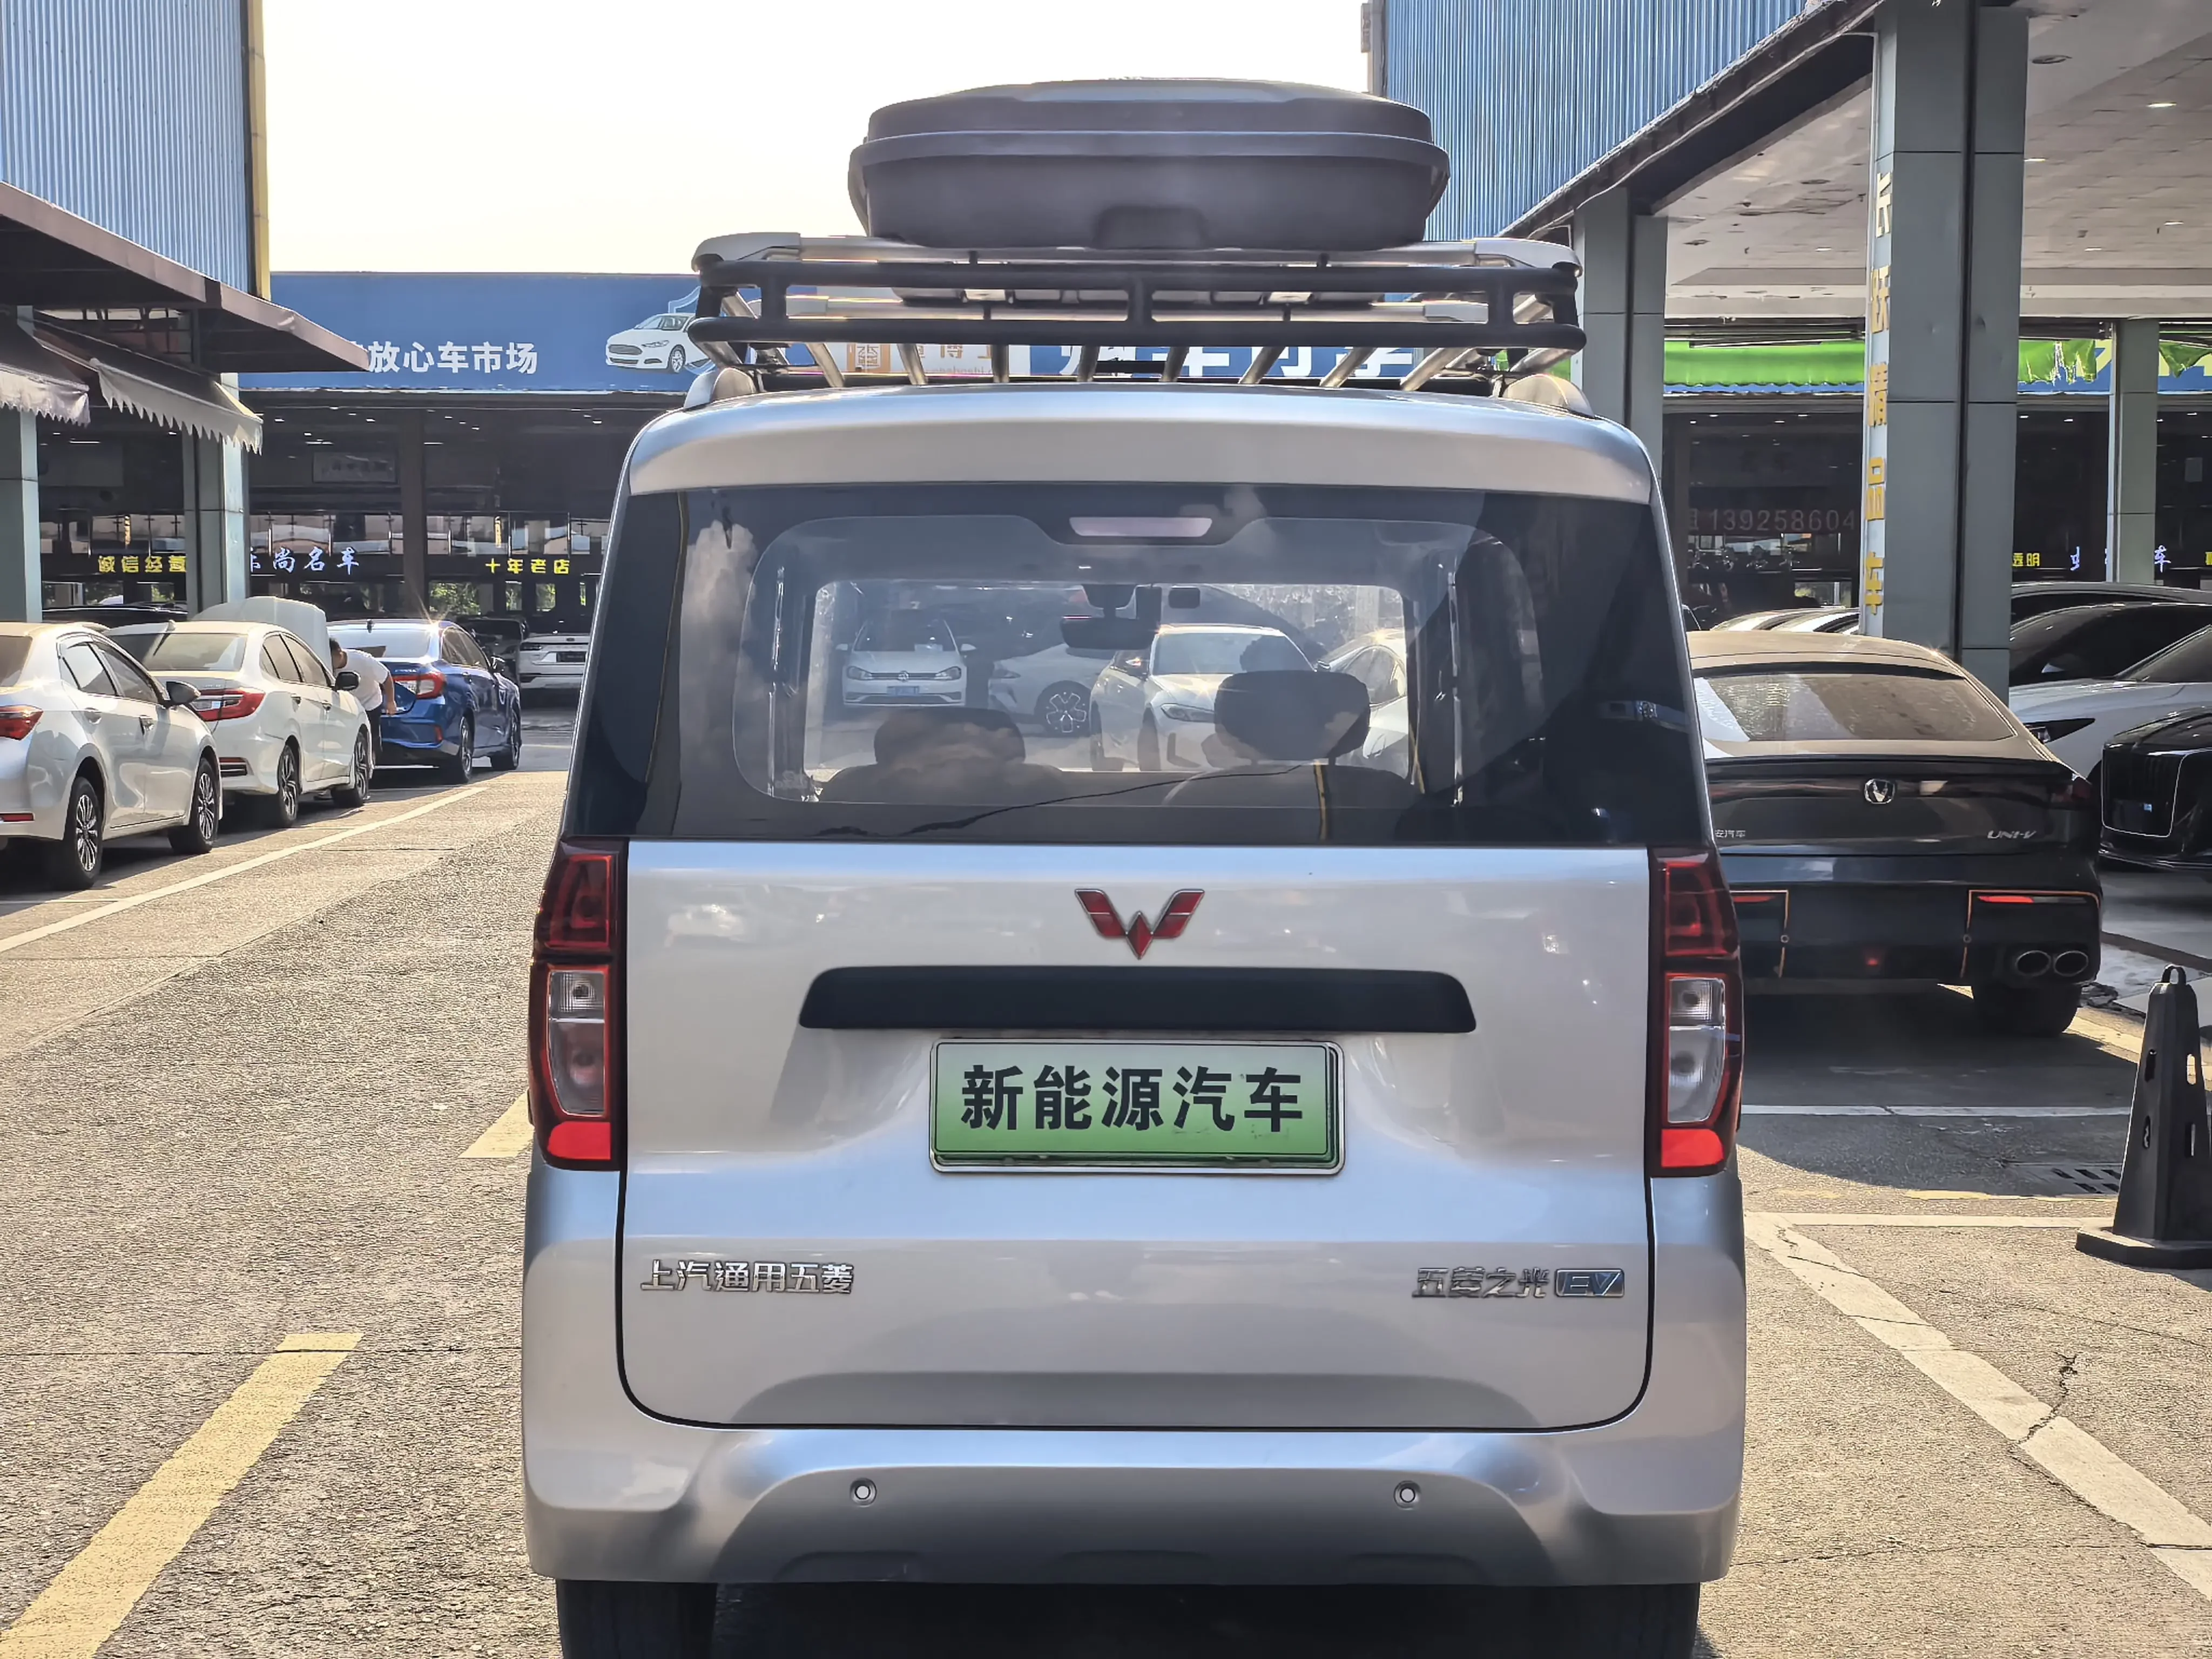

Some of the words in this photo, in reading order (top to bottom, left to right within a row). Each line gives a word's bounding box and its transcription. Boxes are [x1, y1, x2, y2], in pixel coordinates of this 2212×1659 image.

[351, 341, 538, 374] 放心车市场
[1709, 508, 1856, 532] 139258604
[98, 555, 186, 573] 诚信经营
[485, 557, 571, 575] 十年老店
[1987, 830, 2037, 839] UNI-V
[960, 1064, 1304, 1133] 新能源汽车
[640, 1258, 855, 1294] 上汽通用五菱
[1412, 1266, 1550, 1298] 五菱之光
[1560, 1271, 1621, 1297] EV
